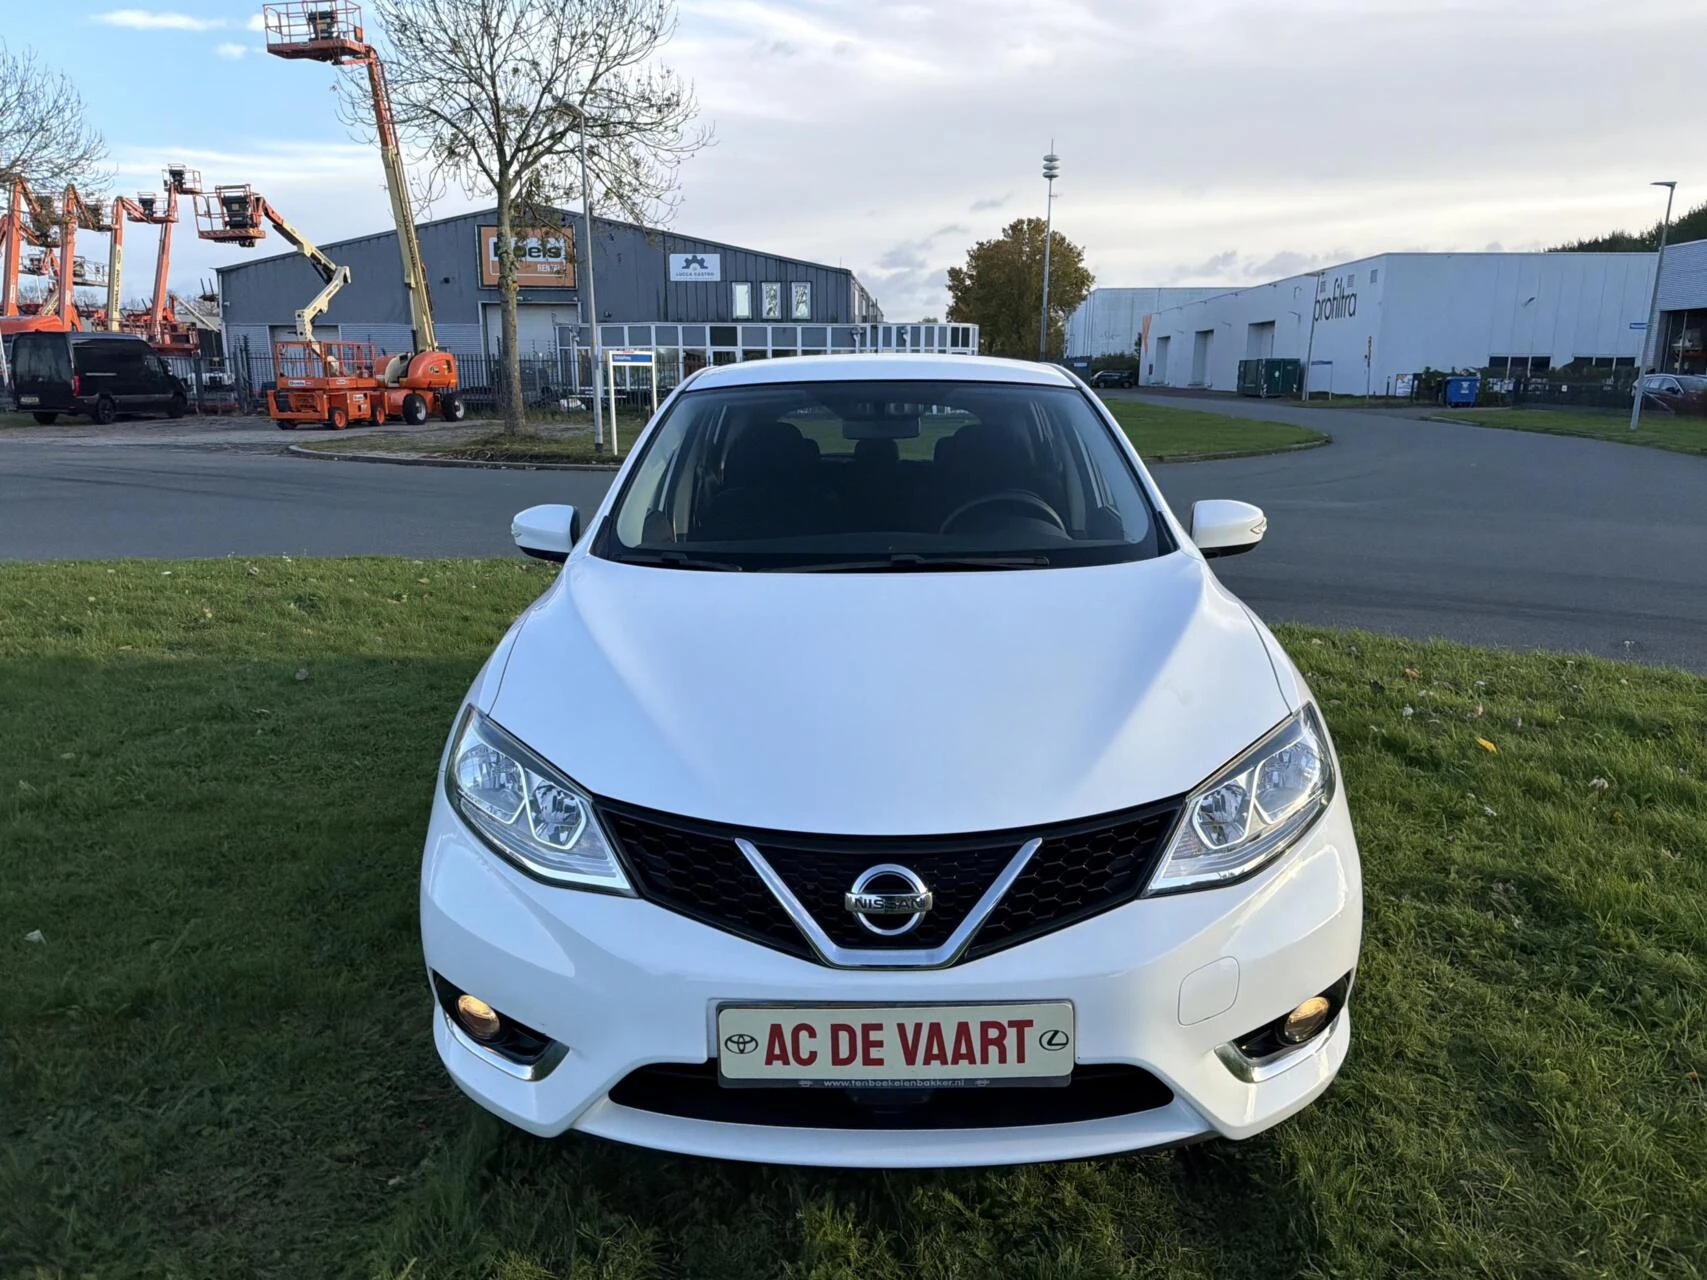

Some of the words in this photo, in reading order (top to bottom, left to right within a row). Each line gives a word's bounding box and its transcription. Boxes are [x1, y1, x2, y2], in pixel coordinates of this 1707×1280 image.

[494, 241, 562, 258] oels
[1314, 276, 1357, 322] profiltra
[854, 898, 925, 910] NISSAN
[765, 1023, 818, 1066] AC
[830, 1023, 885, 1066] DE
[896, 1019, 1034, 1066] VAART
